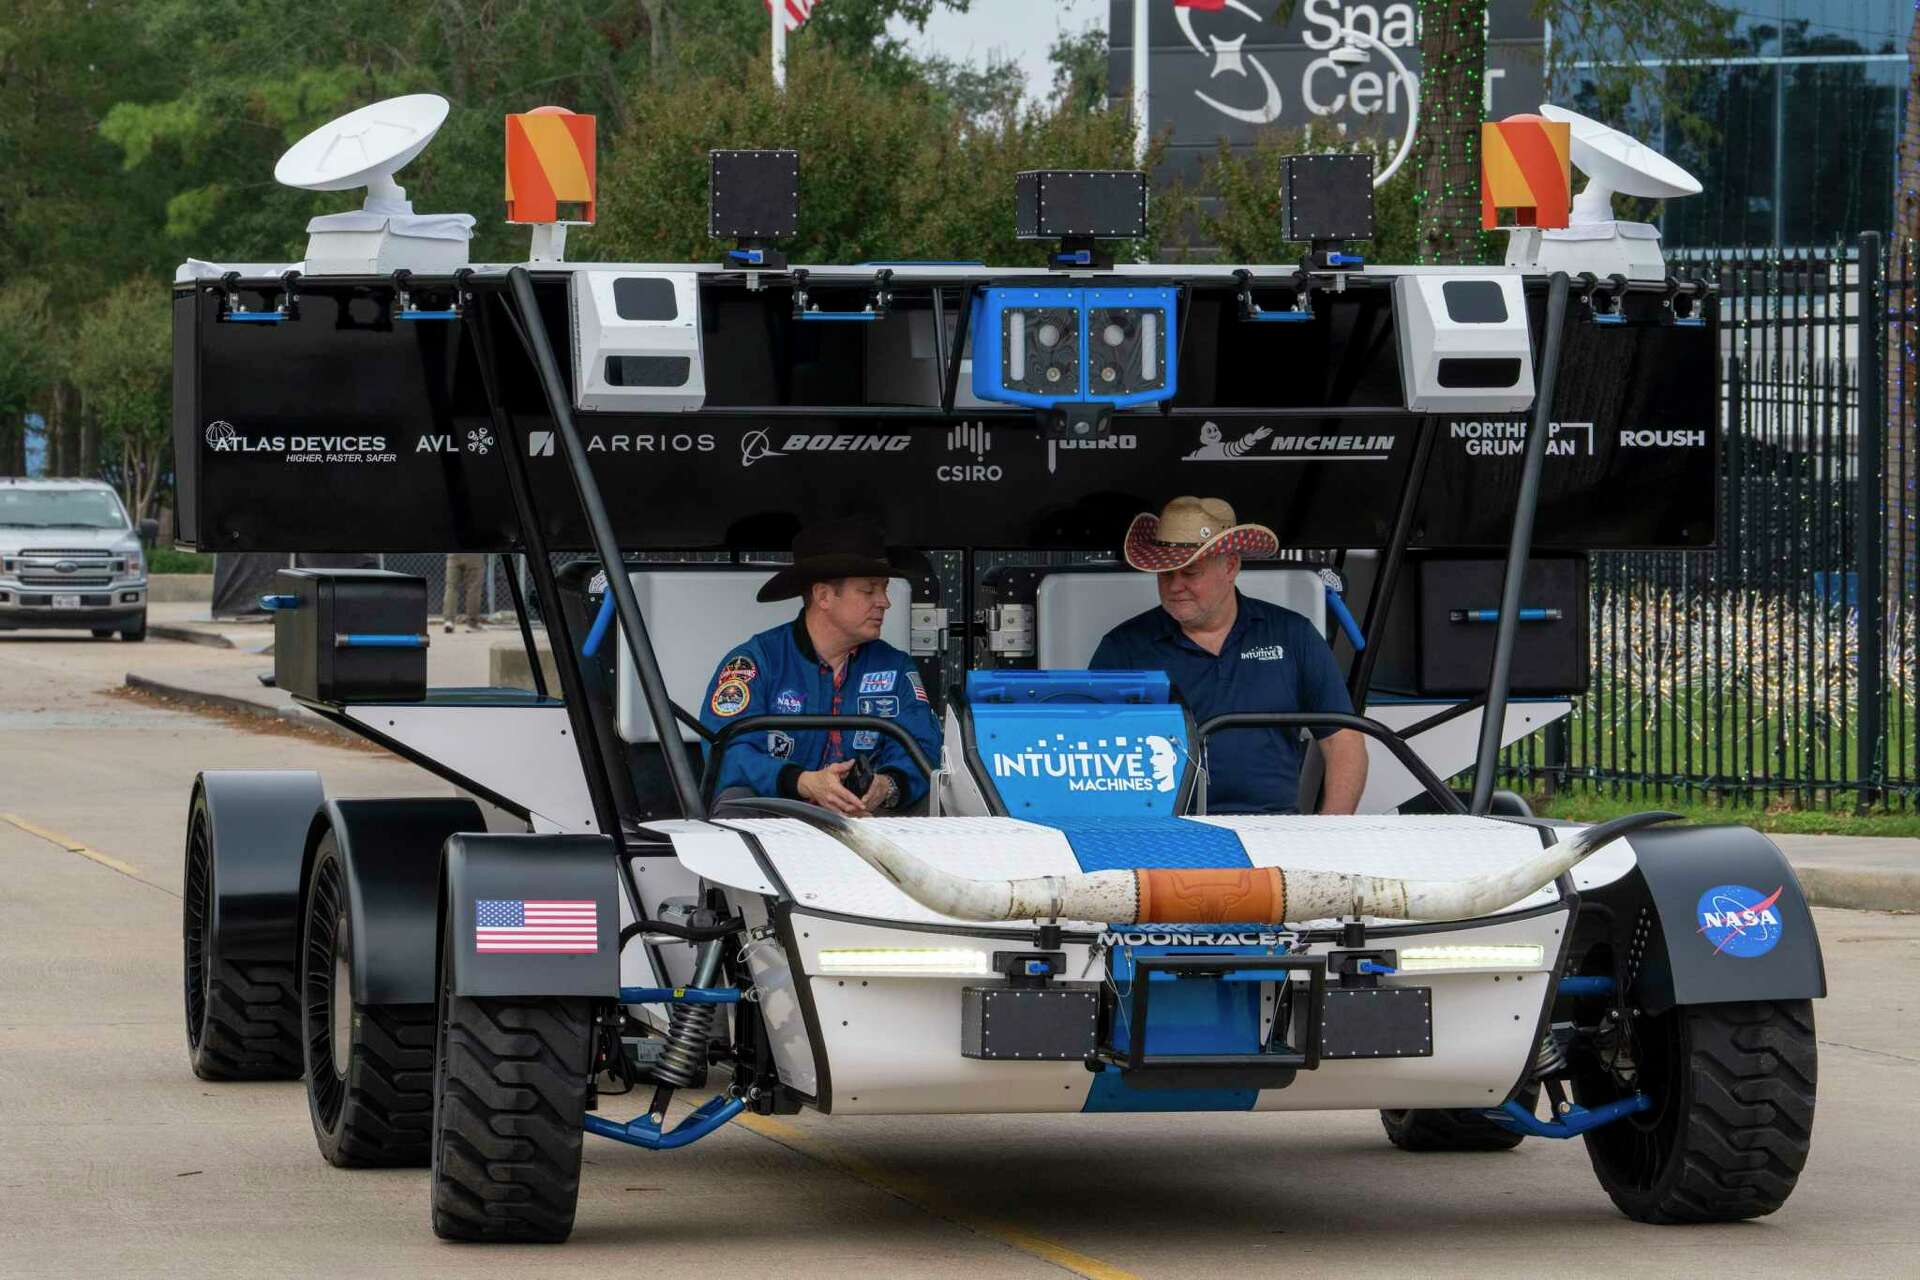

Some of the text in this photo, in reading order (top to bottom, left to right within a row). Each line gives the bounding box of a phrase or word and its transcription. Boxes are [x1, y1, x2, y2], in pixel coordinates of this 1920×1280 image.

[1302, 0, 1490, 50] Spa
[1302, 57, 1506, 116] Cenr
[1451, 422, 1561, 438] NORTHP
[1620, 429, 1706, 447] ROUSH
[216, 436, 386, 452] ATLAS DEVICES
[416, 435, 459, 453] AVL
[782, 434, 912, 451] BOEING
[1271, 434, 1396, 451] MICHELIN
[1465, 439, 1576, 456] GRUMAN
[286, 454, 397, 465] HIGHER, FASTER, SAFER
[937, 465, 1003, 481] CSIRO
[777, 697, 801, 706] NASA
[993, 753, 1145, 778] INTUITIVE
[1069, 777, 1154, 791] MACHINES
[1703, 910, 1778, 928] NASA
[1097, 932, 1300, 947] MOONRACER
